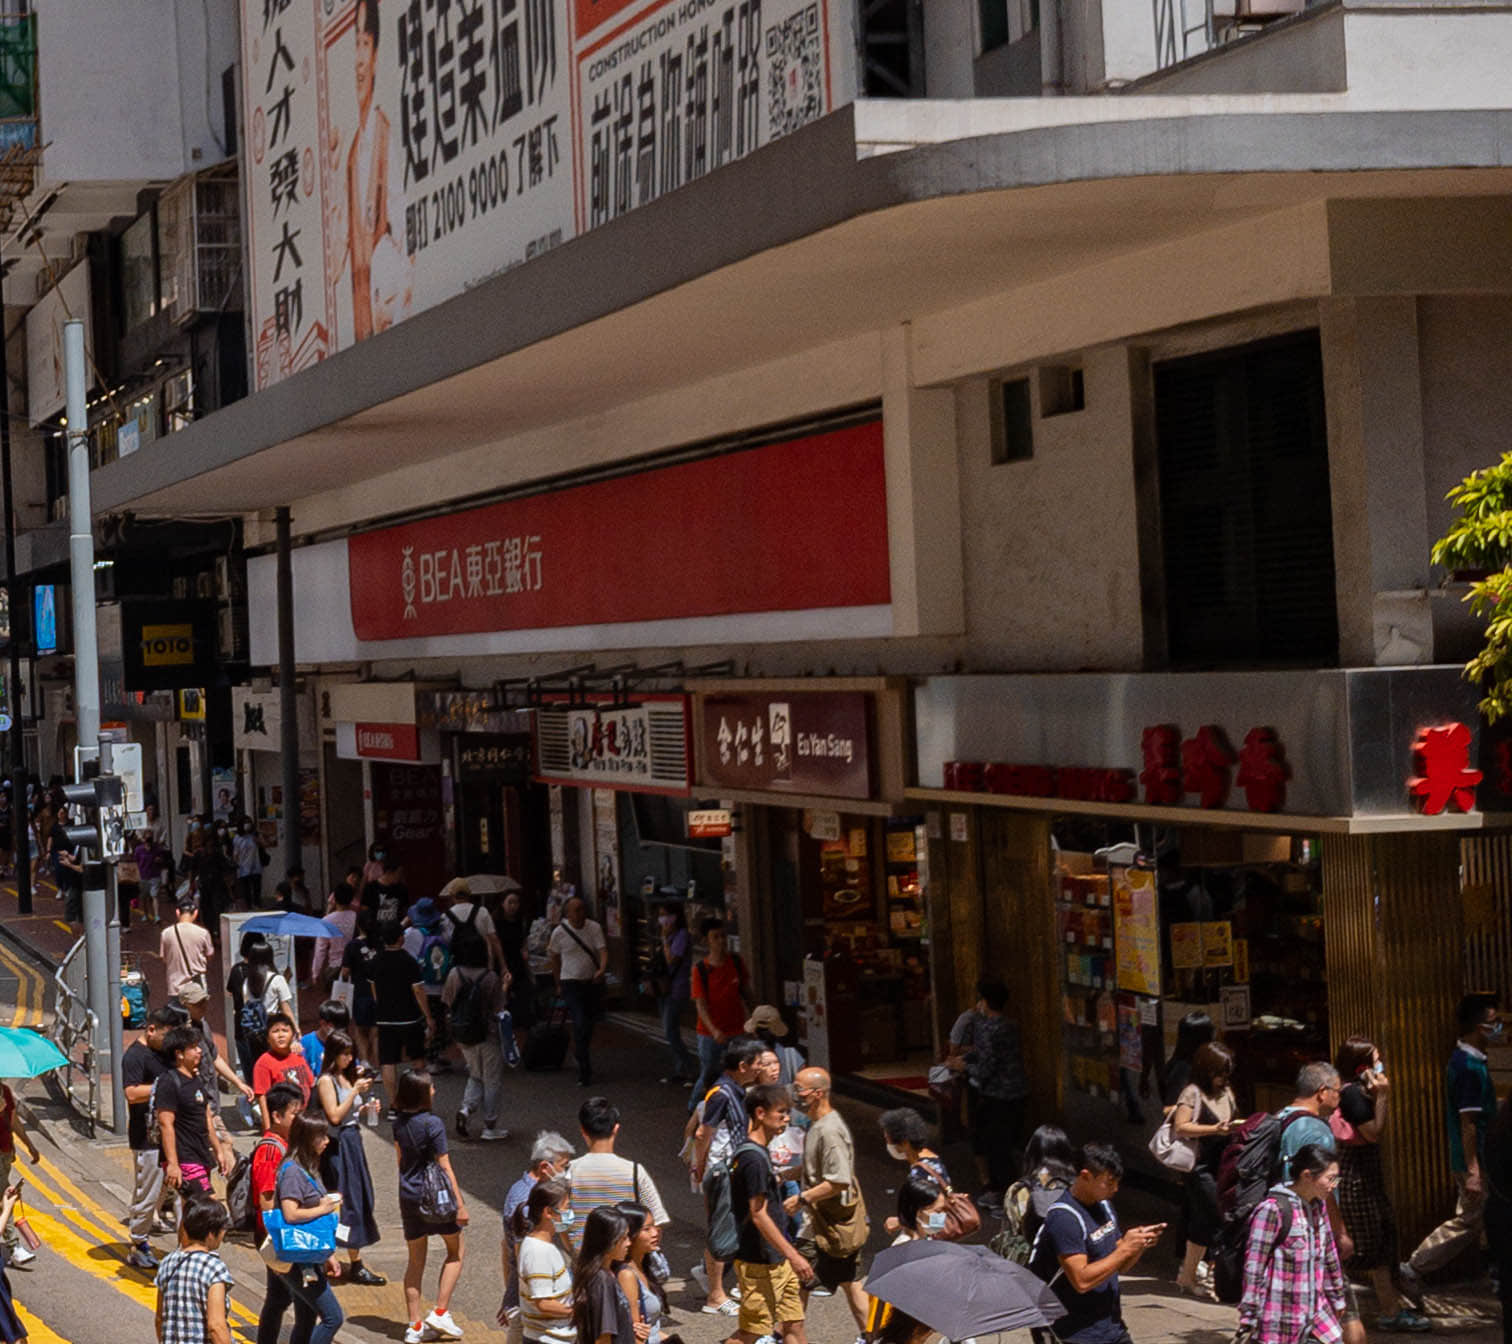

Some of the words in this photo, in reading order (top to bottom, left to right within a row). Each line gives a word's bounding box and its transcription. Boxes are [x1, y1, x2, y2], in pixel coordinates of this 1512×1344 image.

[589, 6, 676, 82] CONSTRUCTION
[433, 175, 466, 242] 2100
[469, 149, 509, 220] 9000
[420, 547, 466, 602] BEA
[466, 536, 543, 599] 東亞銀行
[797, 732, 810, 756] Eu
[809, 732, 828, 757] Yan
[828, 732, 853, 764] Sang
